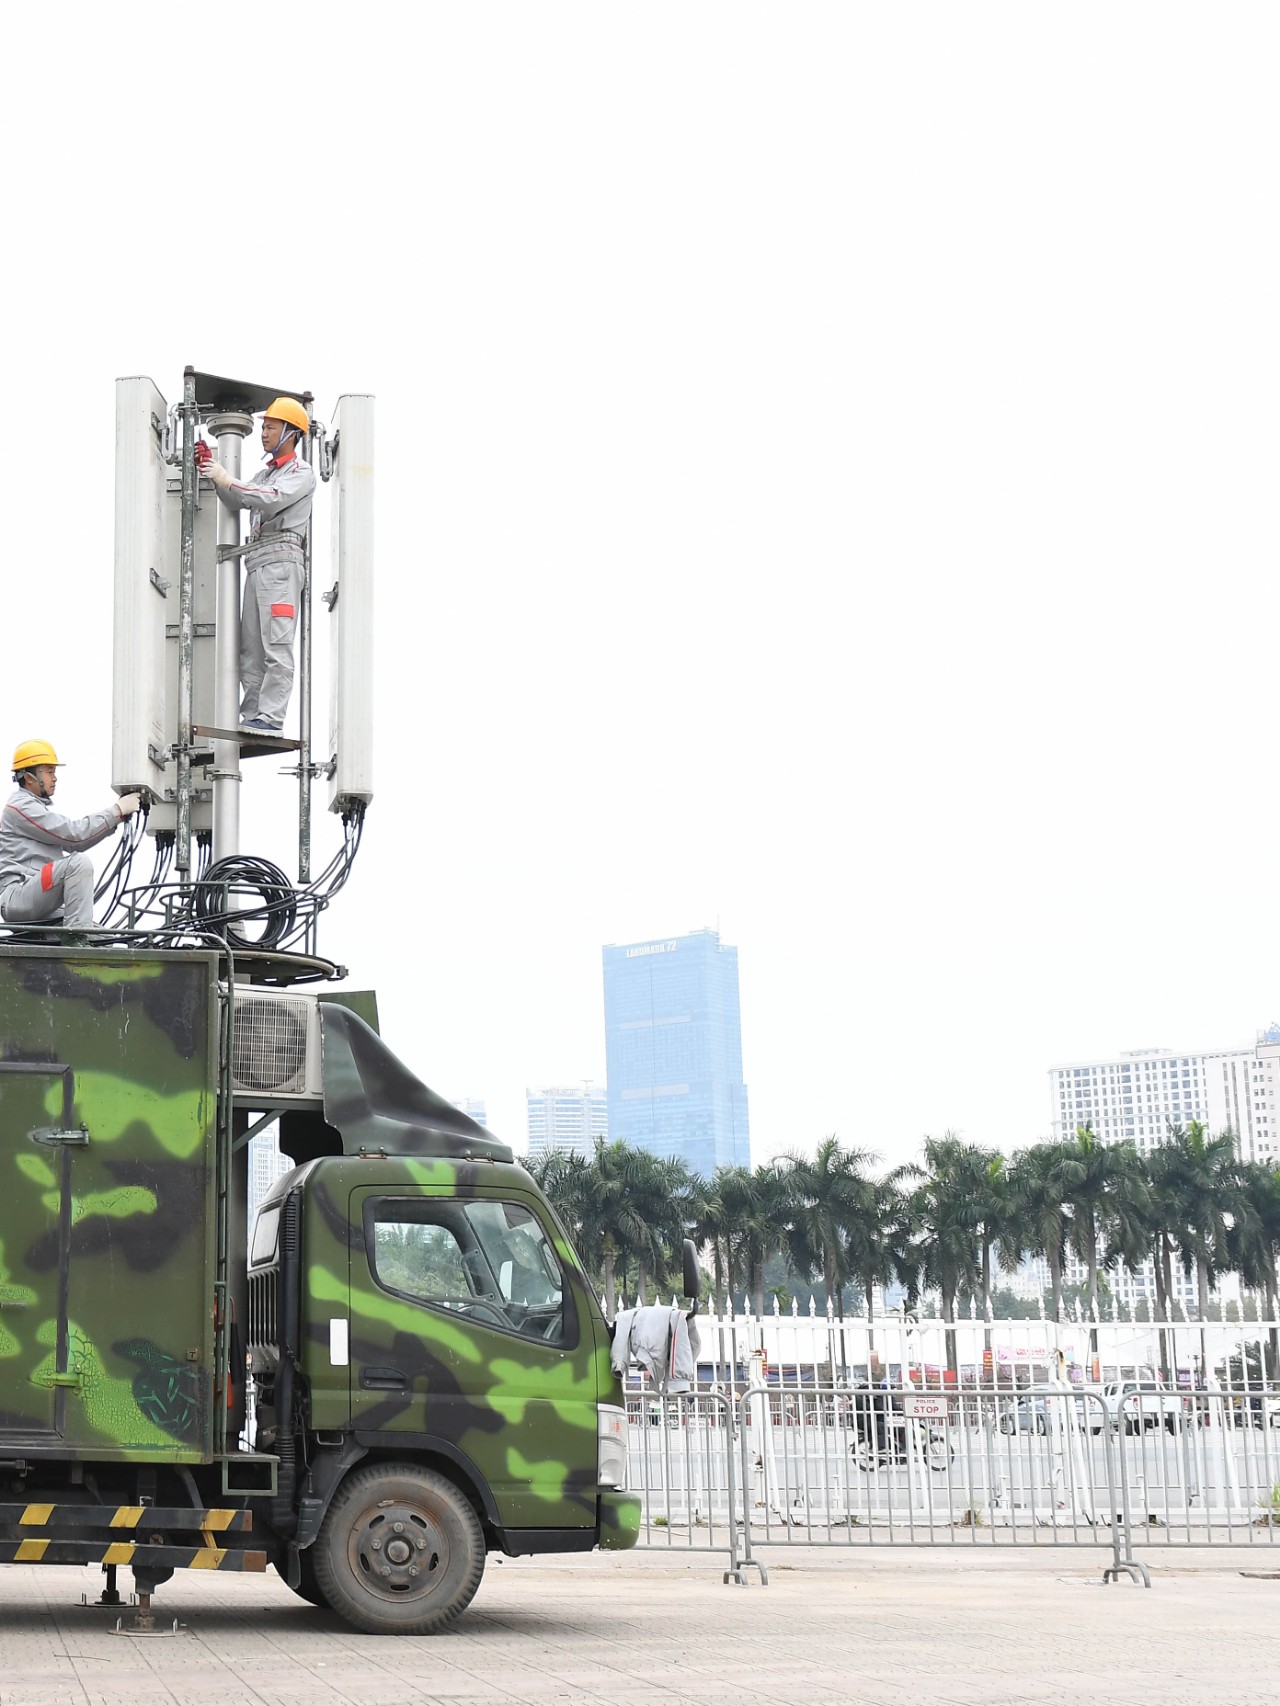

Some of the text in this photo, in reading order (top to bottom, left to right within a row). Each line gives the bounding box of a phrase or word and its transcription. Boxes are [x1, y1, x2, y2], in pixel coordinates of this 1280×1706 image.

[626, 940, 677, 958] LANDMARK 72
[913, 1406, 939, 1414] STOP
